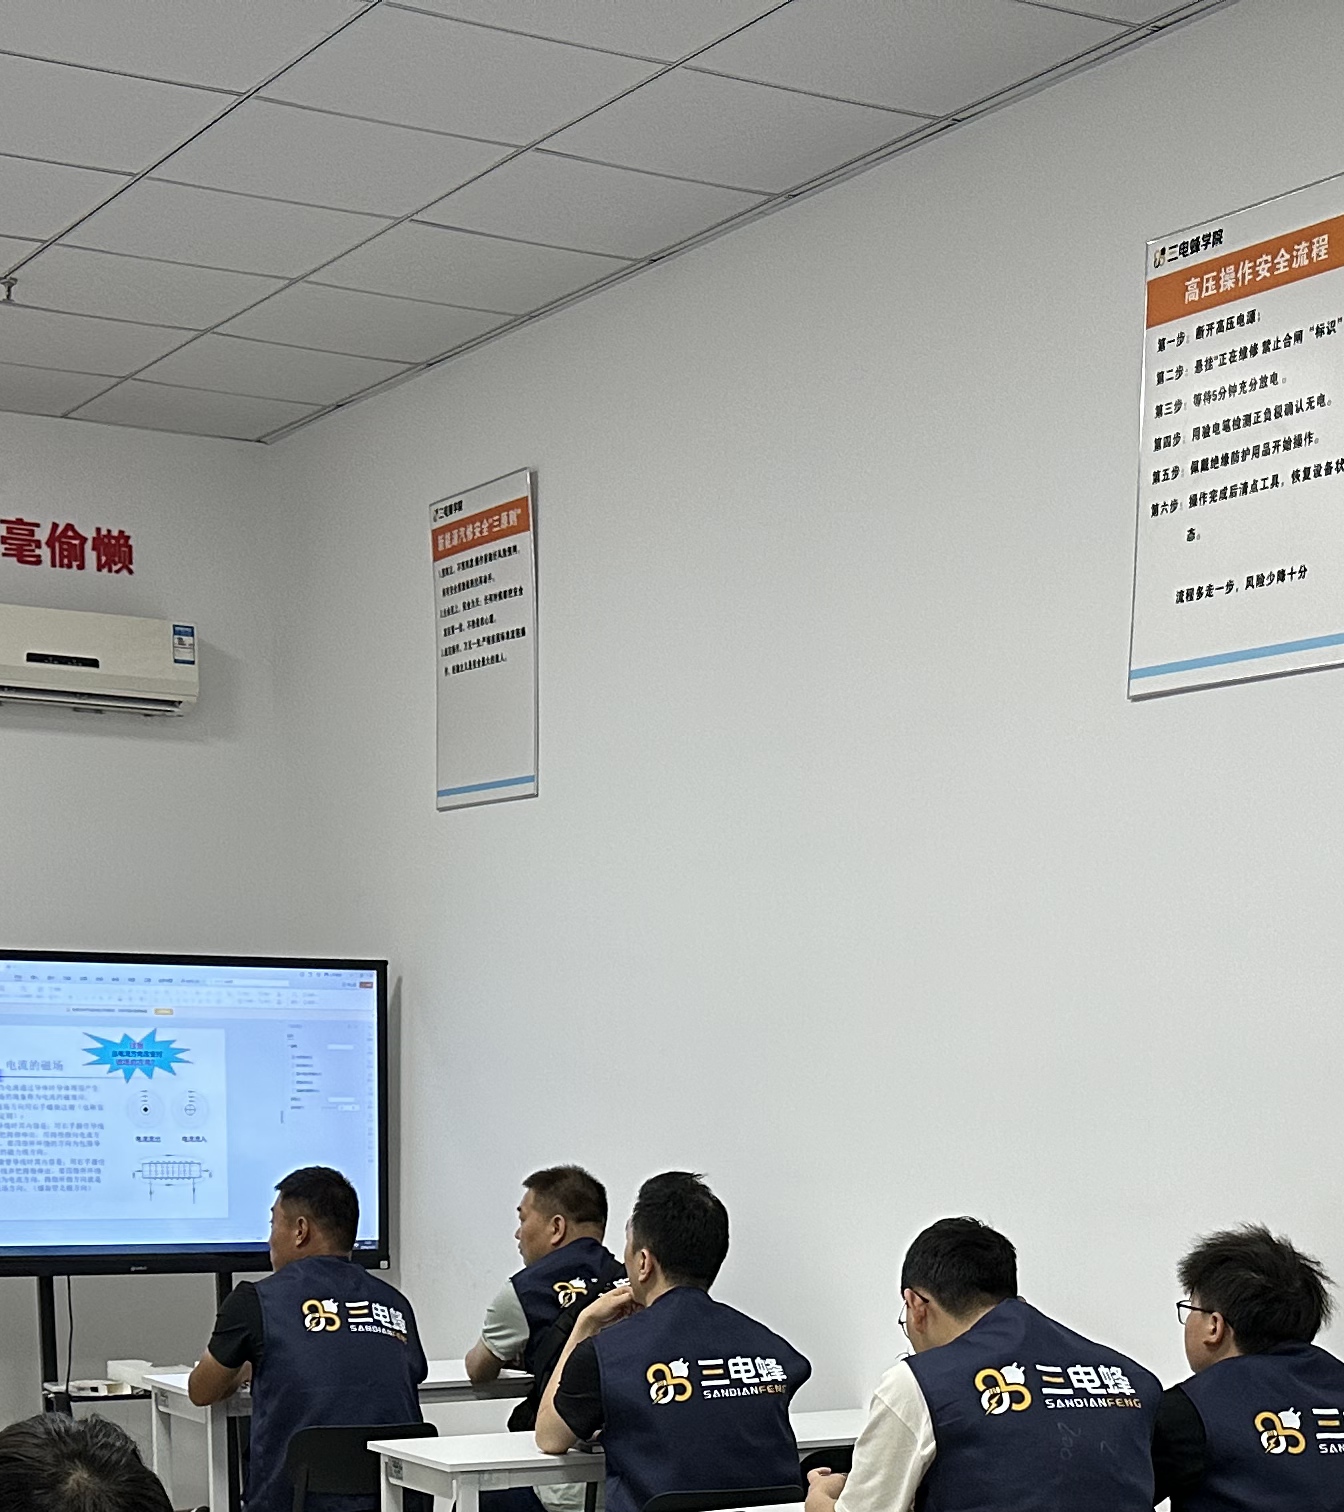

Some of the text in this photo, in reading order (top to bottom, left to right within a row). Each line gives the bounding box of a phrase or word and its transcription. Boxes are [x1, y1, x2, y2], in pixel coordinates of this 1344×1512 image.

[1184, 234, 1329, 304] 高压操作安全流程
[345, 1301, 407, 1334] 三电蜂
[698, 1356, 787, 1387] 三电蜂
[1035, 1364, 1136, 1396] 三电蜂
[1044, 1397, 1142, 1410] SANDIANFENG
